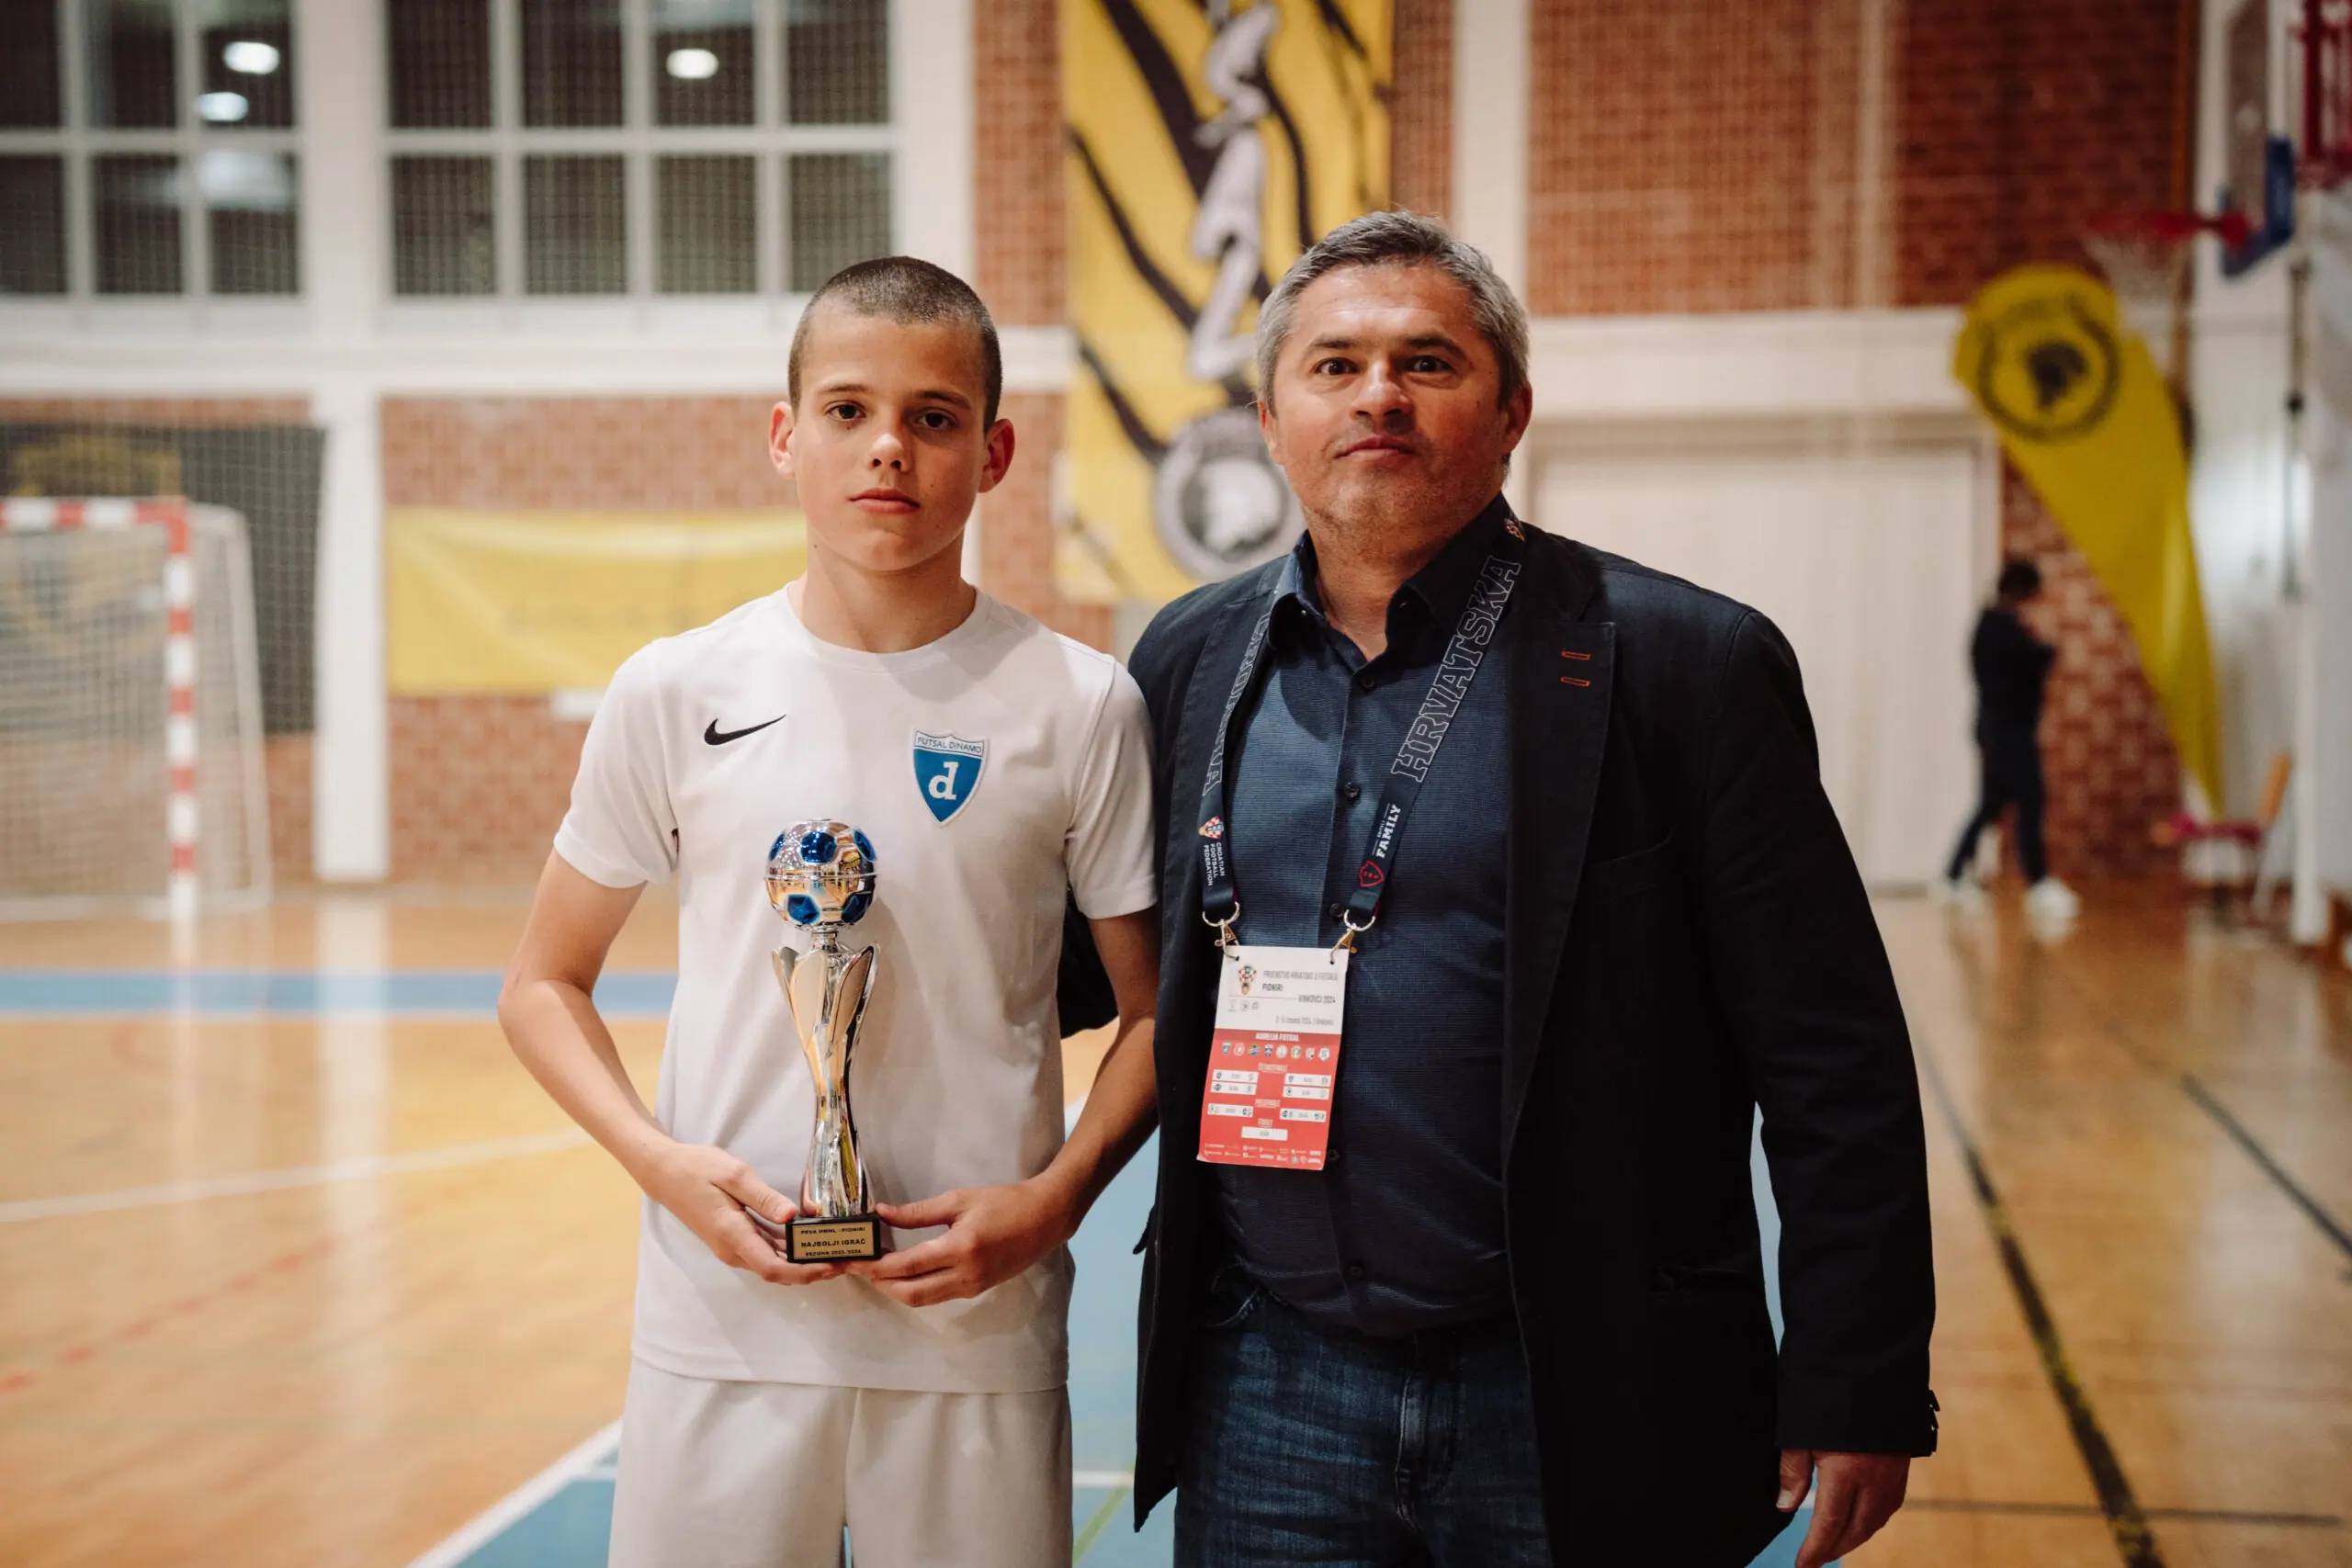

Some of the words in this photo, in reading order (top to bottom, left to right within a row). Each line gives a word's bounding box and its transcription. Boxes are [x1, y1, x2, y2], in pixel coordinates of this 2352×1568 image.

[1390, 555, 1521, 783] HRVATSKA
[917, 737, 947, 749] FUTSAL
[949, 741, 982, 753] DINAMO
[928, 761, 959, 800] d
[1375, 804, 1401, 859] FAMILY
[1204, 844, 1213, 886] FEDERATION
[1210, 843, 1218, 879] FOOTBALL
[1216, 841, 1226, 876] CROATIAN
